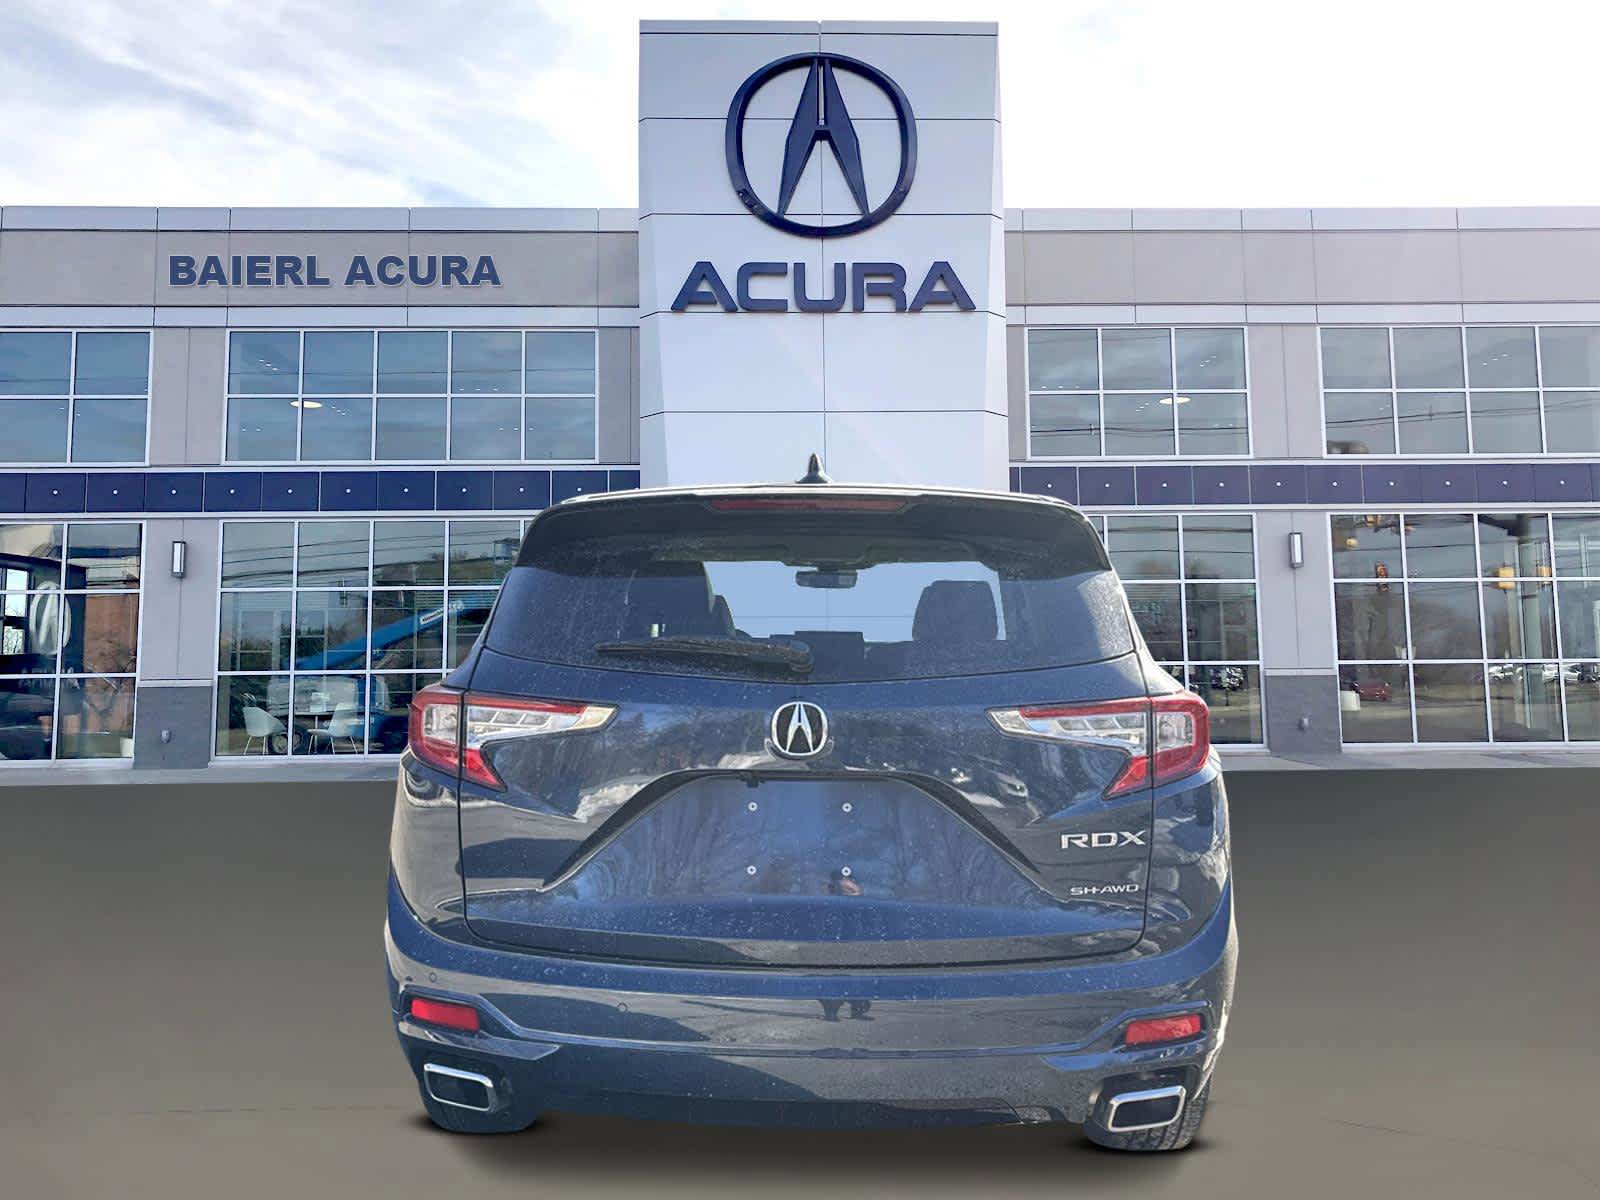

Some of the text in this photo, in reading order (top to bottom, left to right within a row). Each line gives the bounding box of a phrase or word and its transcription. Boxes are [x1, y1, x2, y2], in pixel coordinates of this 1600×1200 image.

[168, 255, 502, 287] BAIERL ACURA
[670, 261, 977, 313] ACURA
[1060, 830, 1146, 850] RDX
